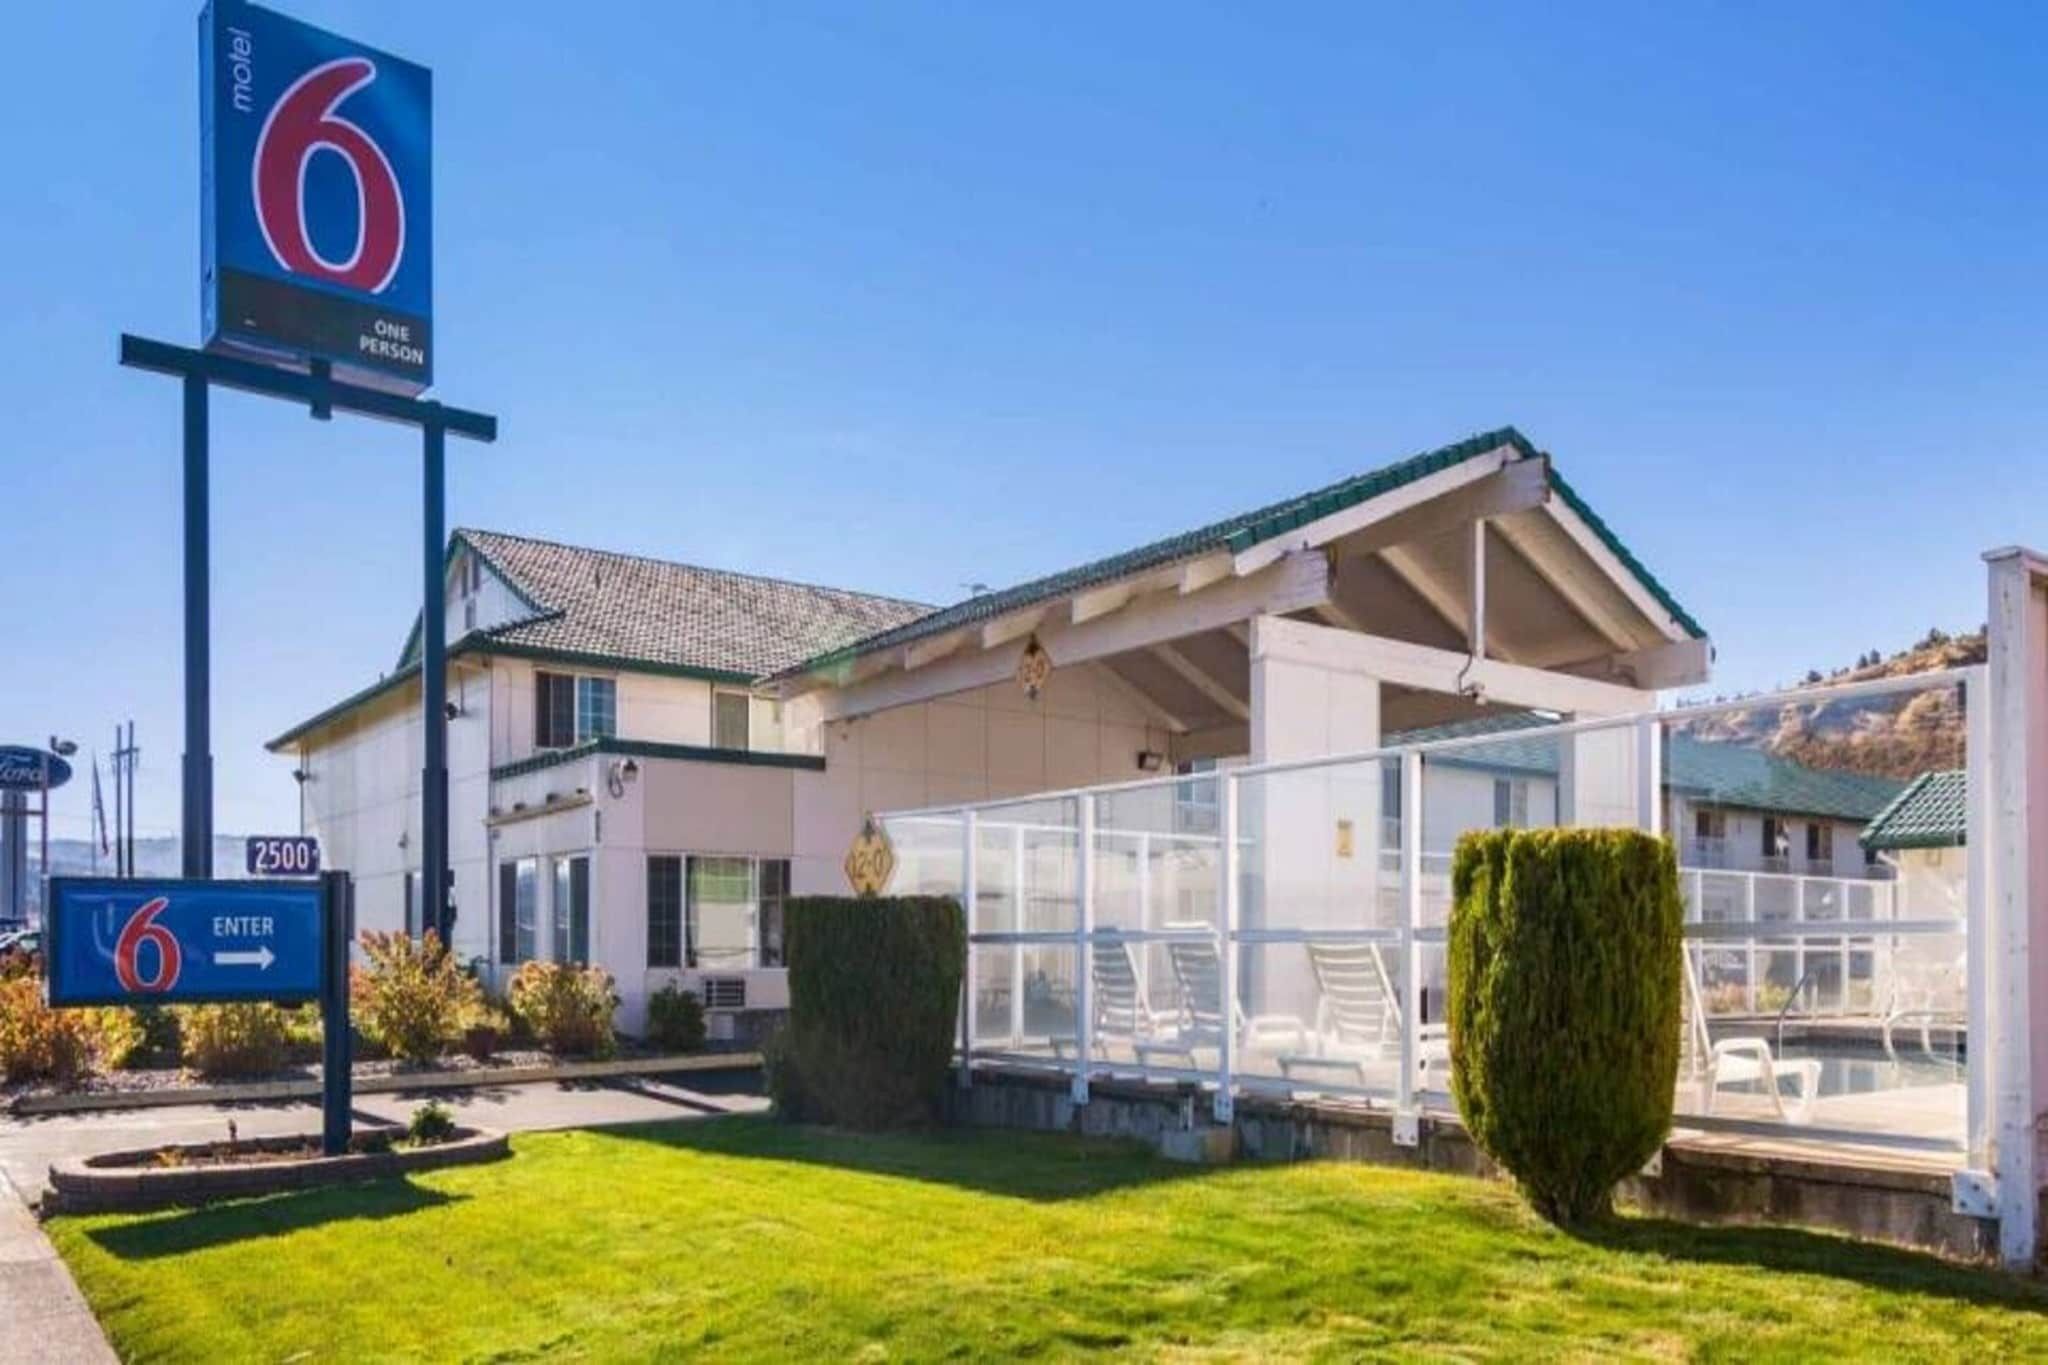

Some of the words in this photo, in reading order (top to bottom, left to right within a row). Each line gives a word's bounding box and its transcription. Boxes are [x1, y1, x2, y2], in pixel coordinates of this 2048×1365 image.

[227, 27, 252, 112] motel
[252, 57, 406, 294] 6
[359, 335, 424, 365] PERSON
[374, 319, 411, 342] ONE
[255, 841, 309, 870] 2500
[114, 897, 182, 993] 6
[212, 916, 274, 937] ENTER
